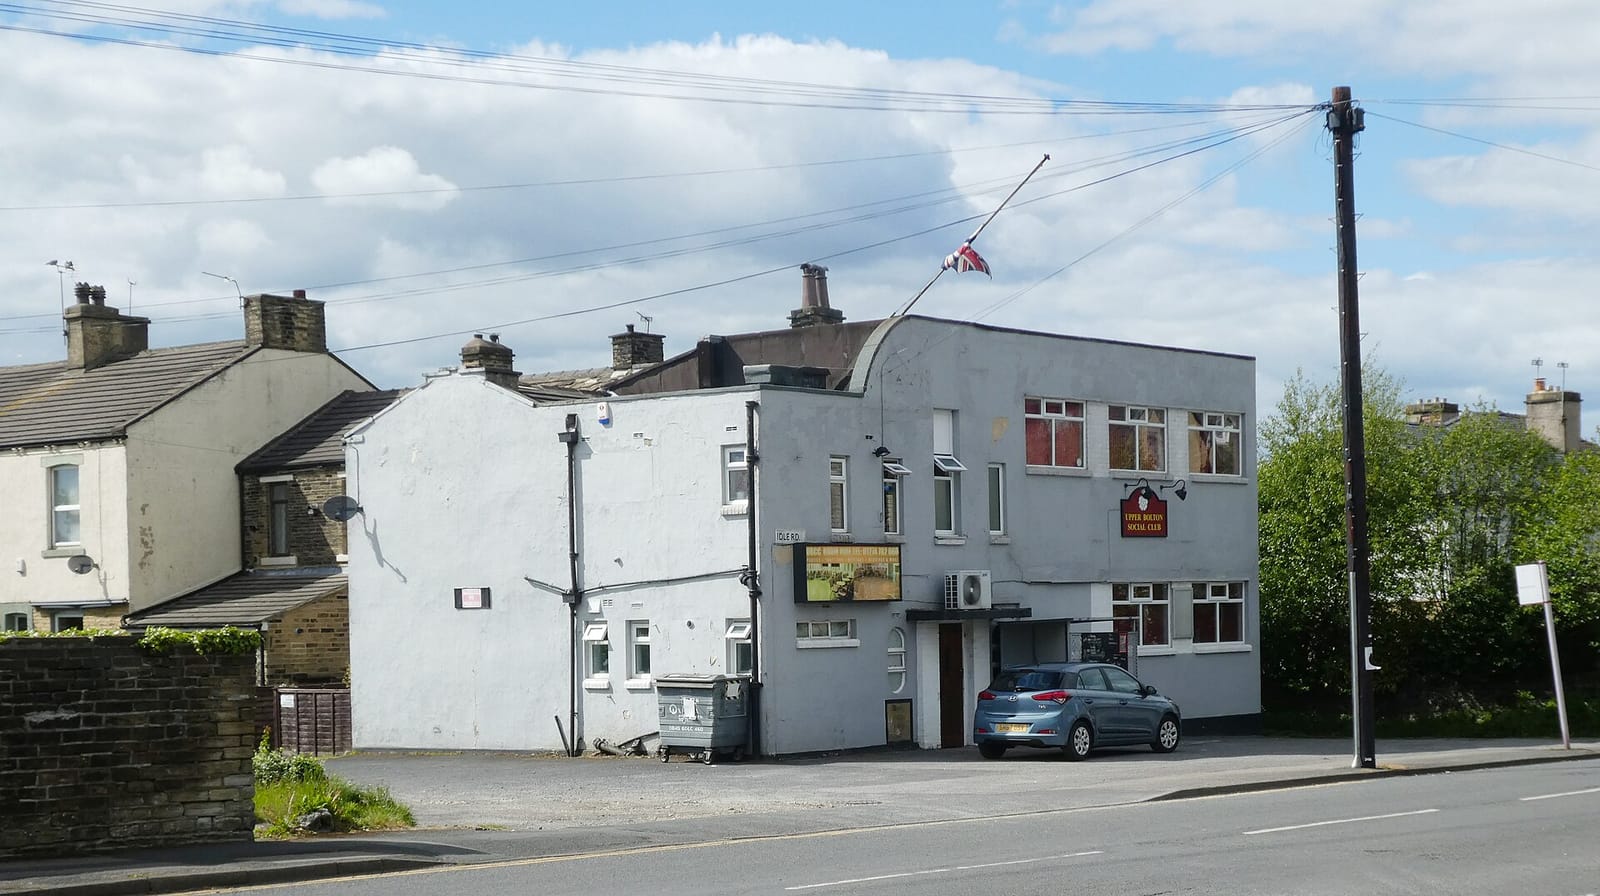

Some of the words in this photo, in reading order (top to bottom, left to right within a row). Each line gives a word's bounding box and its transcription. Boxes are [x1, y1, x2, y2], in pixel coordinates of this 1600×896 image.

[1125, 513, 1142, 521] UPPER
[1143, 513, 1163, 521] BOLTON
[1127, 523, 1146, 531] SOCIAL
[1147, 523, 1162, 531] CLUB
[776, 532, 790, 541] IDLE
